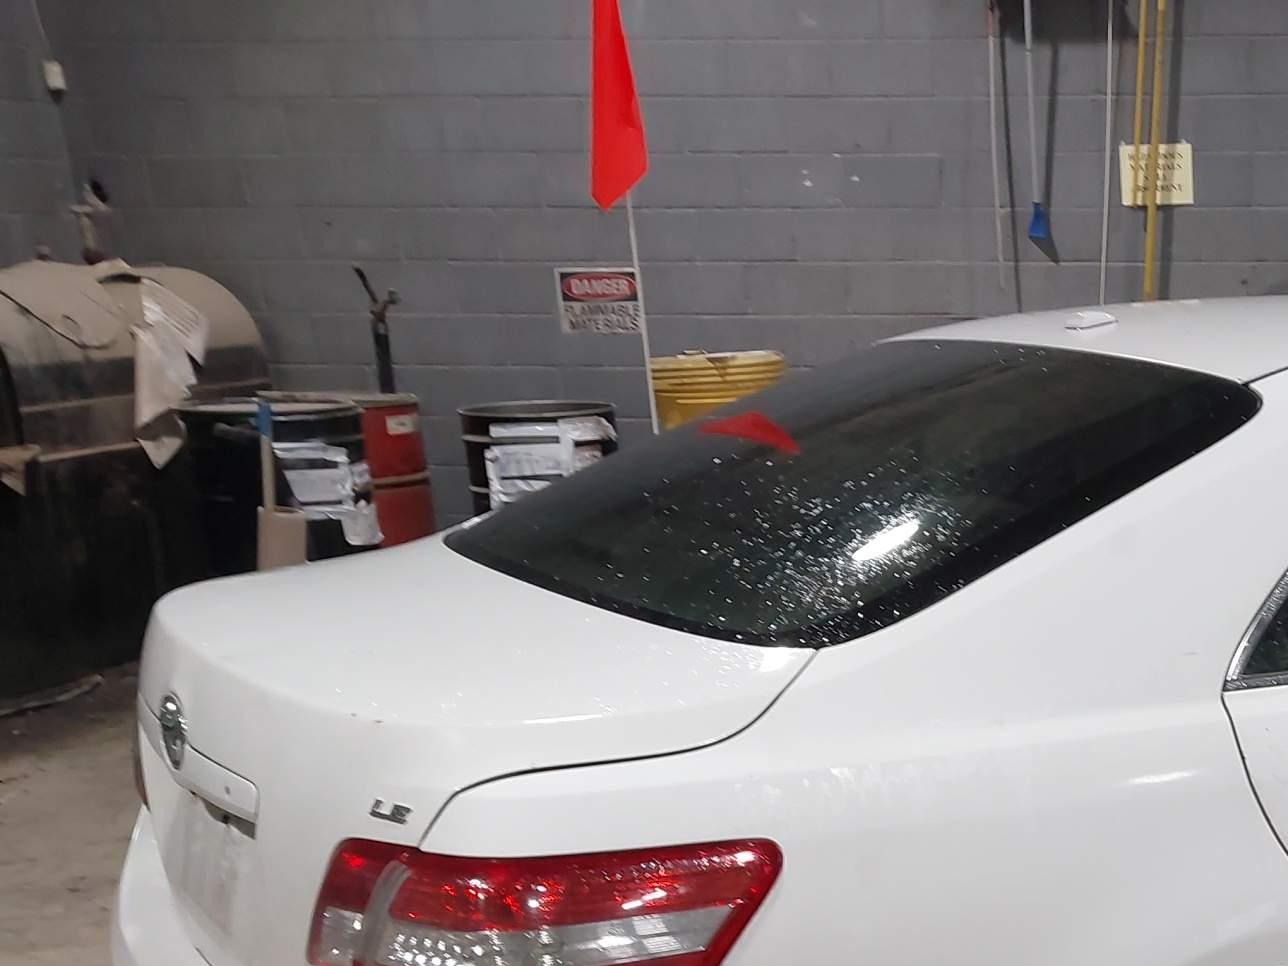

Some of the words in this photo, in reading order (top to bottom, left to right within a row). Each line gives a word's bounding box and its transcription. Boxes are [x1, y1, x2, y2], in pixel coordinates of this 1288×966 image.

[570, 278, 631, 296] DANGER
[564, 304, 641, 317] FLAMMABLE
[568, 315, 640, 330] MATERIALS
[369, 797, 413, 824] LE
